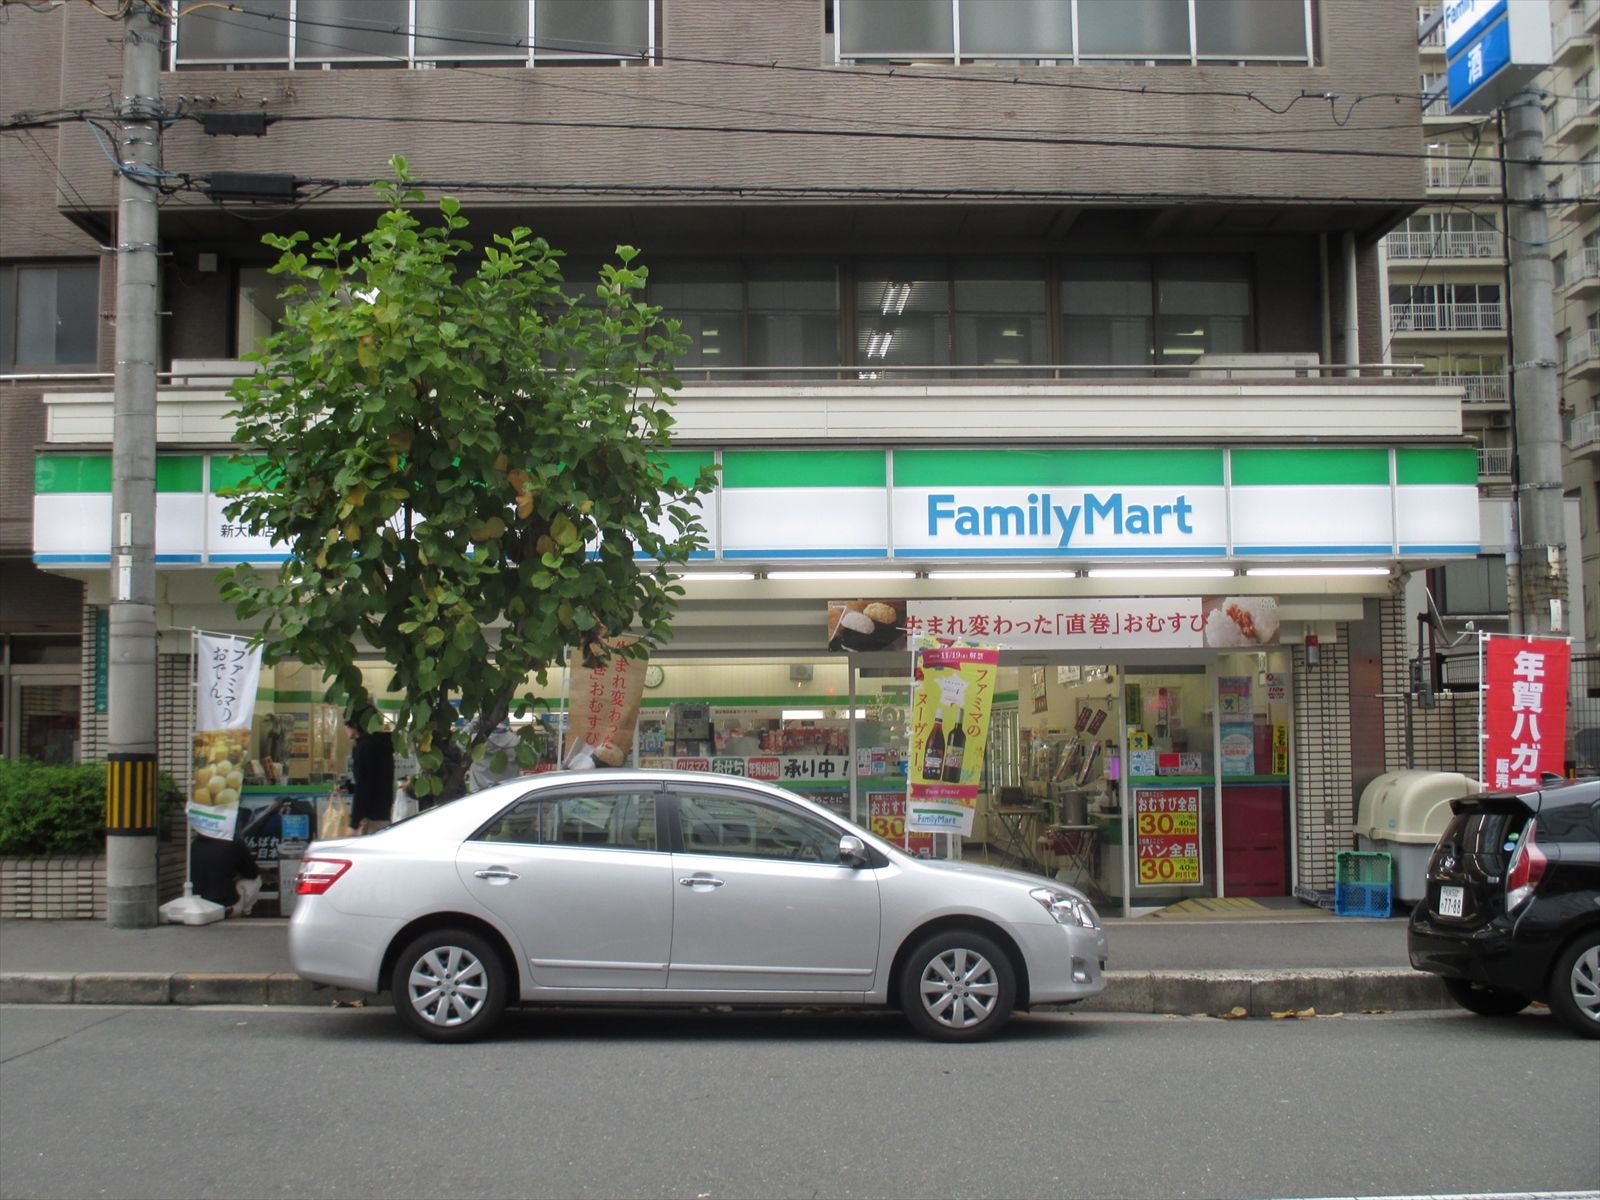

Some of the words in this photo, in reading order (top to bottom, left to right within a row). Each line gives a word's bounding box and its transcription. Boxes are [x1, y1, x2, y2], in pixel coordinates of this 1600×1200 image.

[1467, 42, 1483, 84] 酒
[928, 493, 1193, 548] FamilyMart
[221, 524, 276, 538] 新大店
[967, 669, 988, 738] ファミマの
[1138, 797, 1197, 812] おむすび全品
[917, 815, 956, 825] FamilyMart
[1140, 814, 1174, 834] 30
[1140, 843, 1197, 857] パン全品
[1141, 859, 1175, 880] 30
